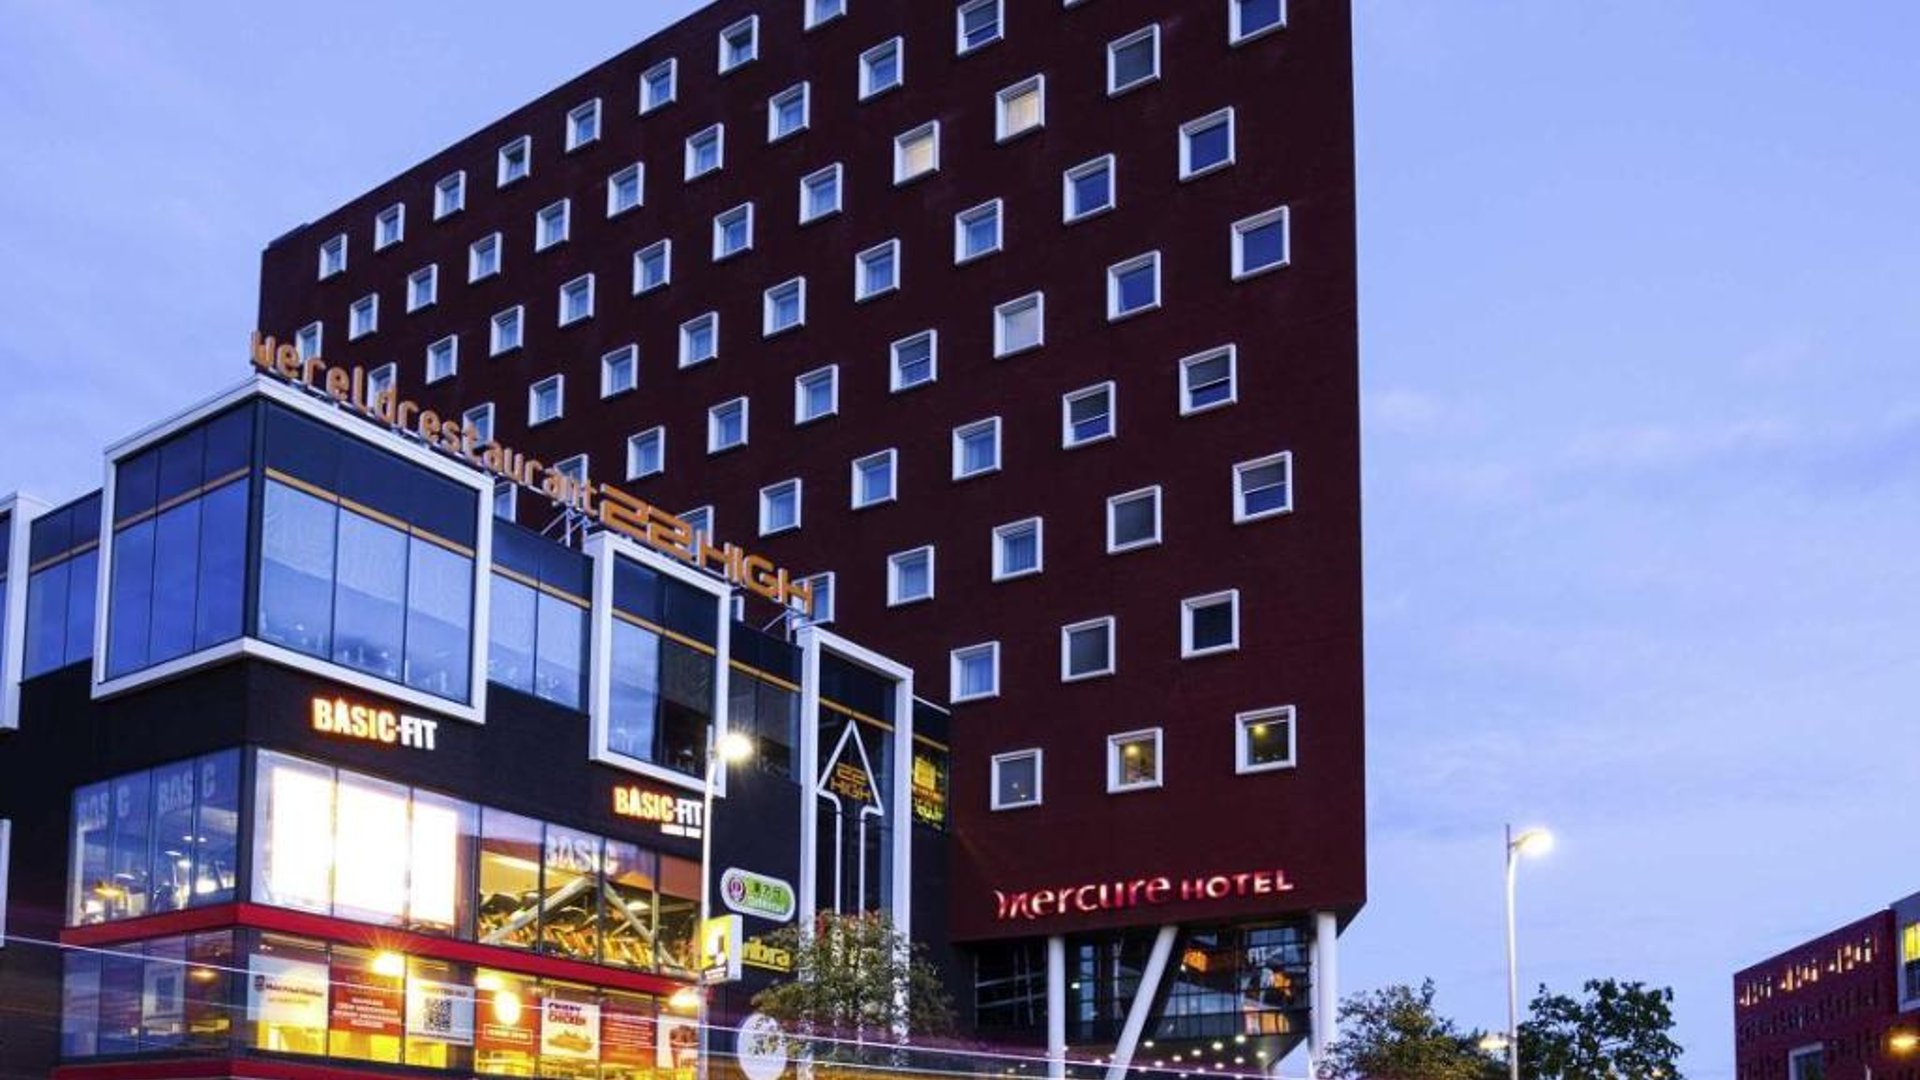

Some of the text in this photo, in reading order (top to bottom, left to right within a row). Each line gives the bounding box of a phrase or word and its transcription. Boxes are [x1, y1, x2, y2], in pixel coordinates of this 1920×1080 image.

[601, 483, 694, 562] 22
[698, 529, 813, 617] HIGH
[1182, 869, 1295, 900] HOTEL
